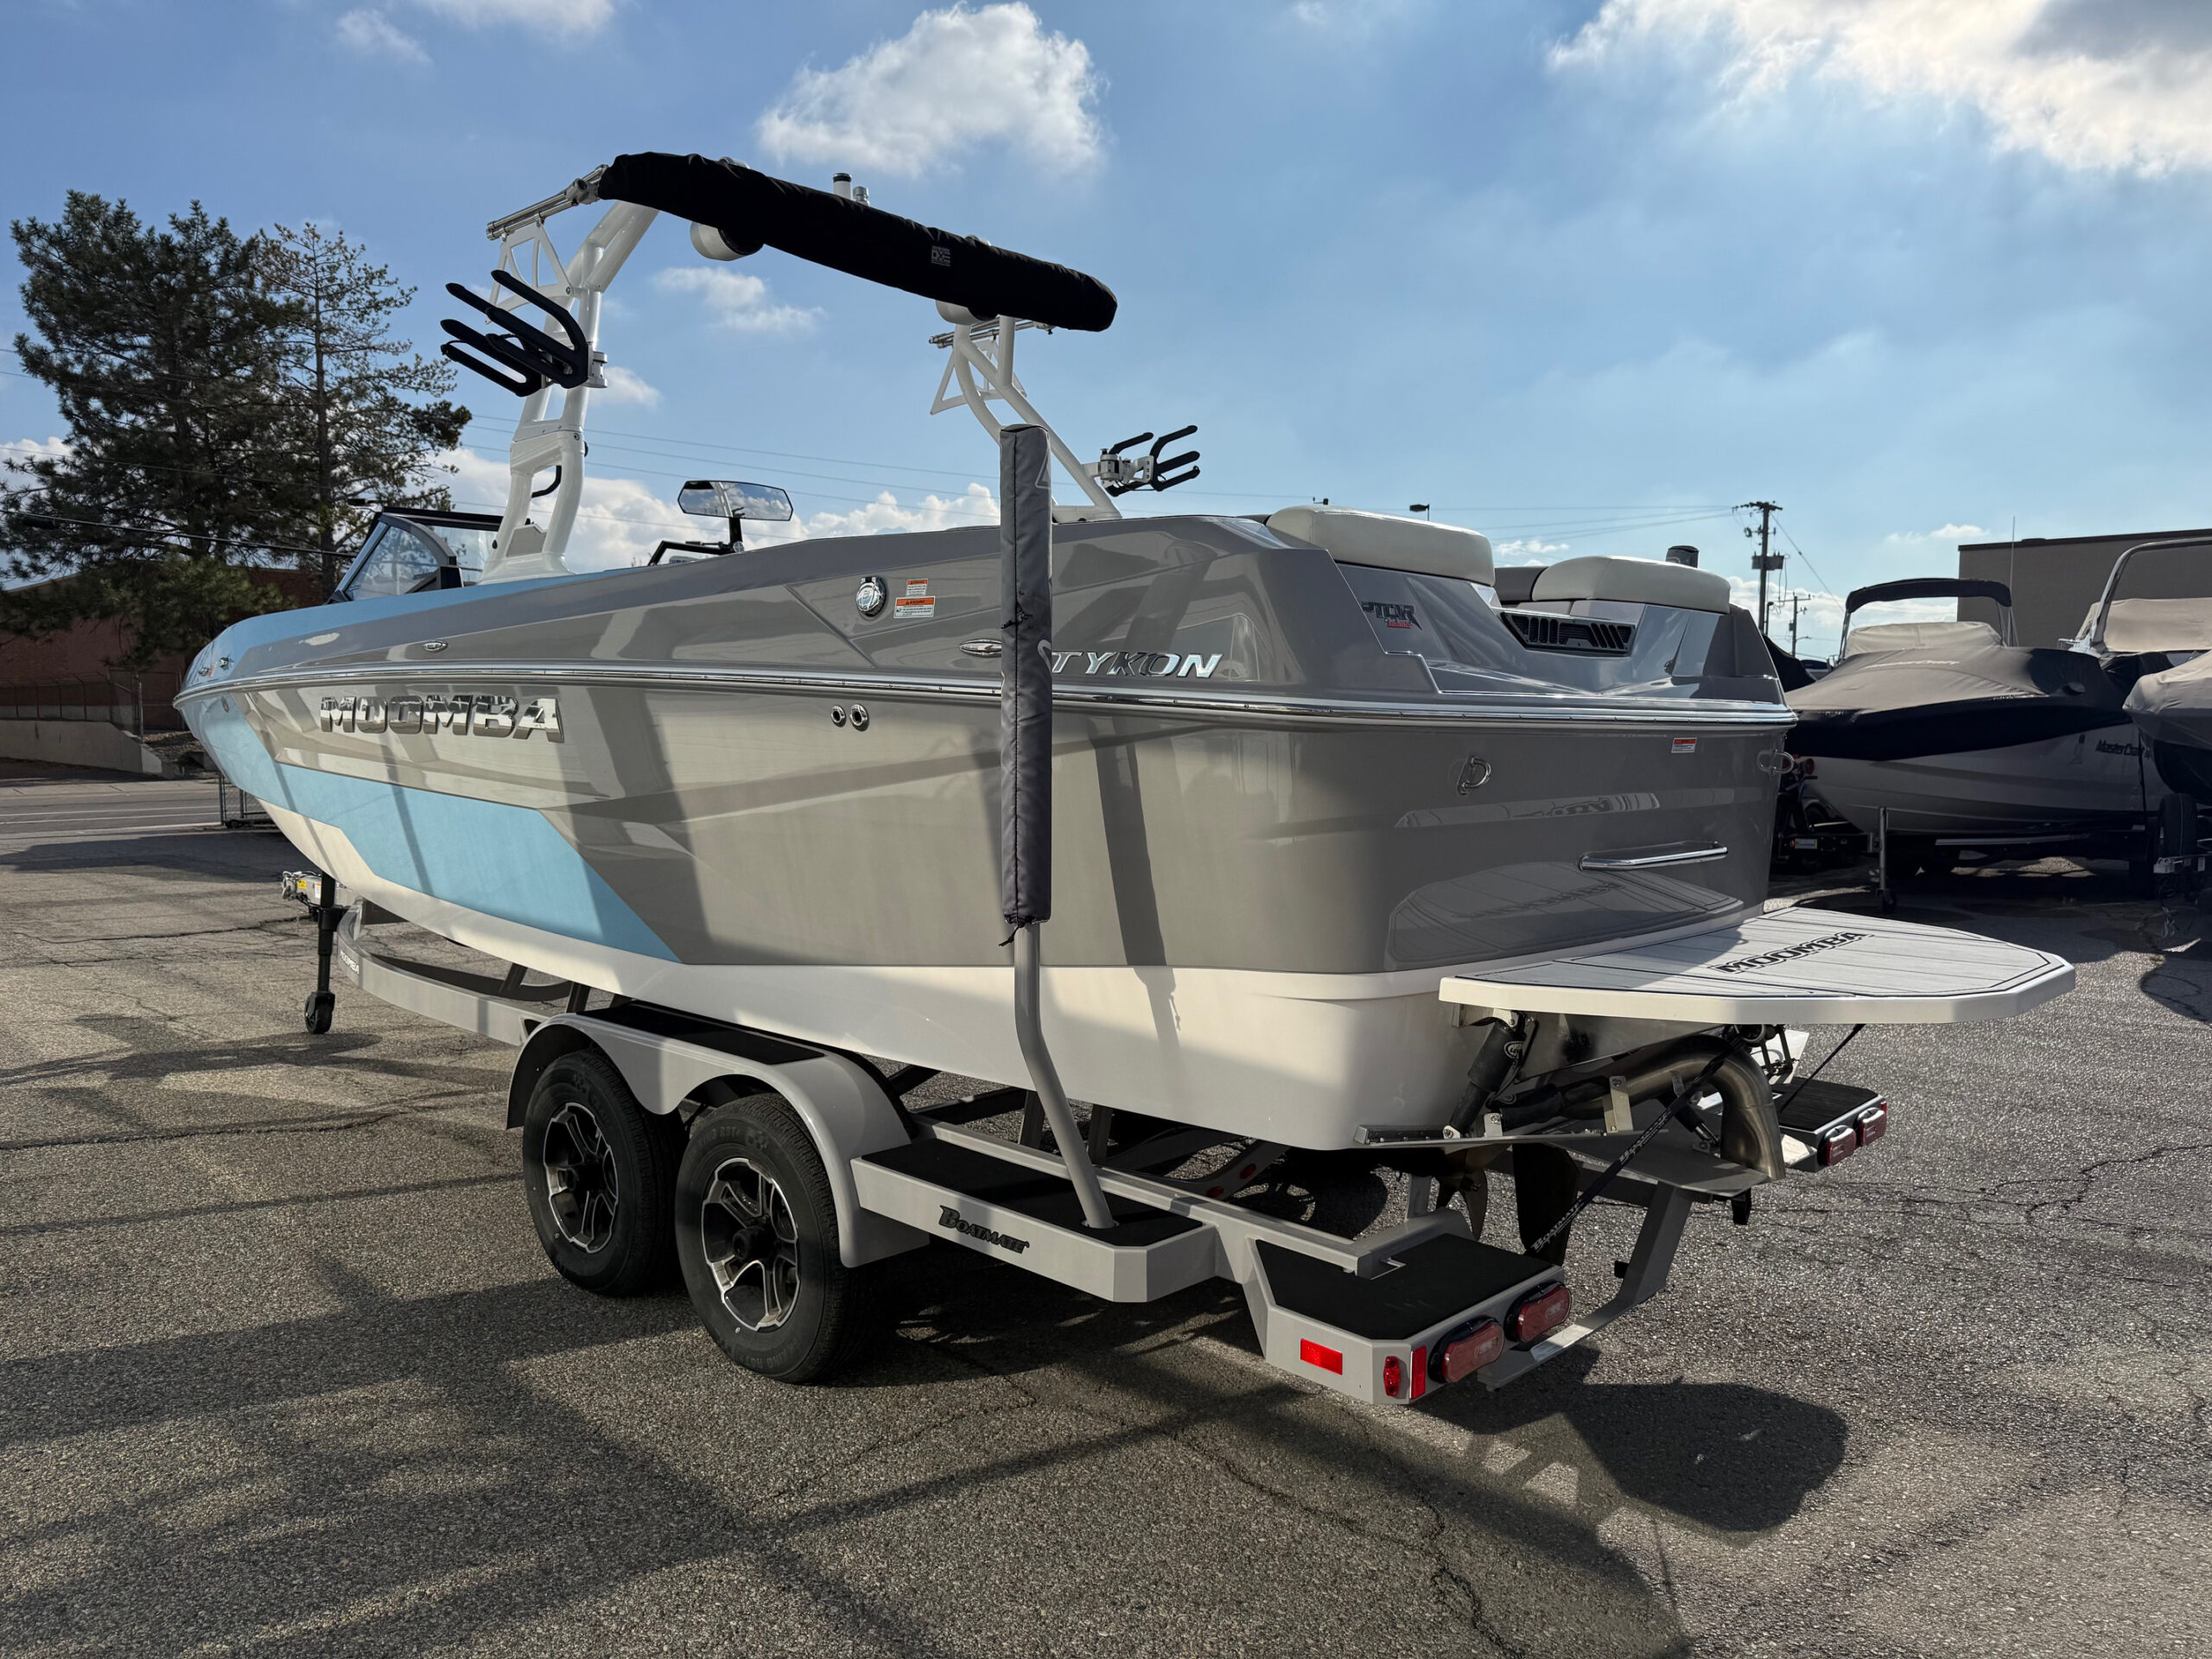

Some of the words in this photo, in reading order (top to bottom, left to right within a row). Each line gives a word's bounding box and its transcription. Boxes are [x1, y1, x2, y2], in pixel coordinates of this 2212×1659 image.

[1052, 652, 1223, 678] TYKON
[320, 695, 564, 743] MOOMBA
[1715, 932, 1868, 973] MOOMBA
